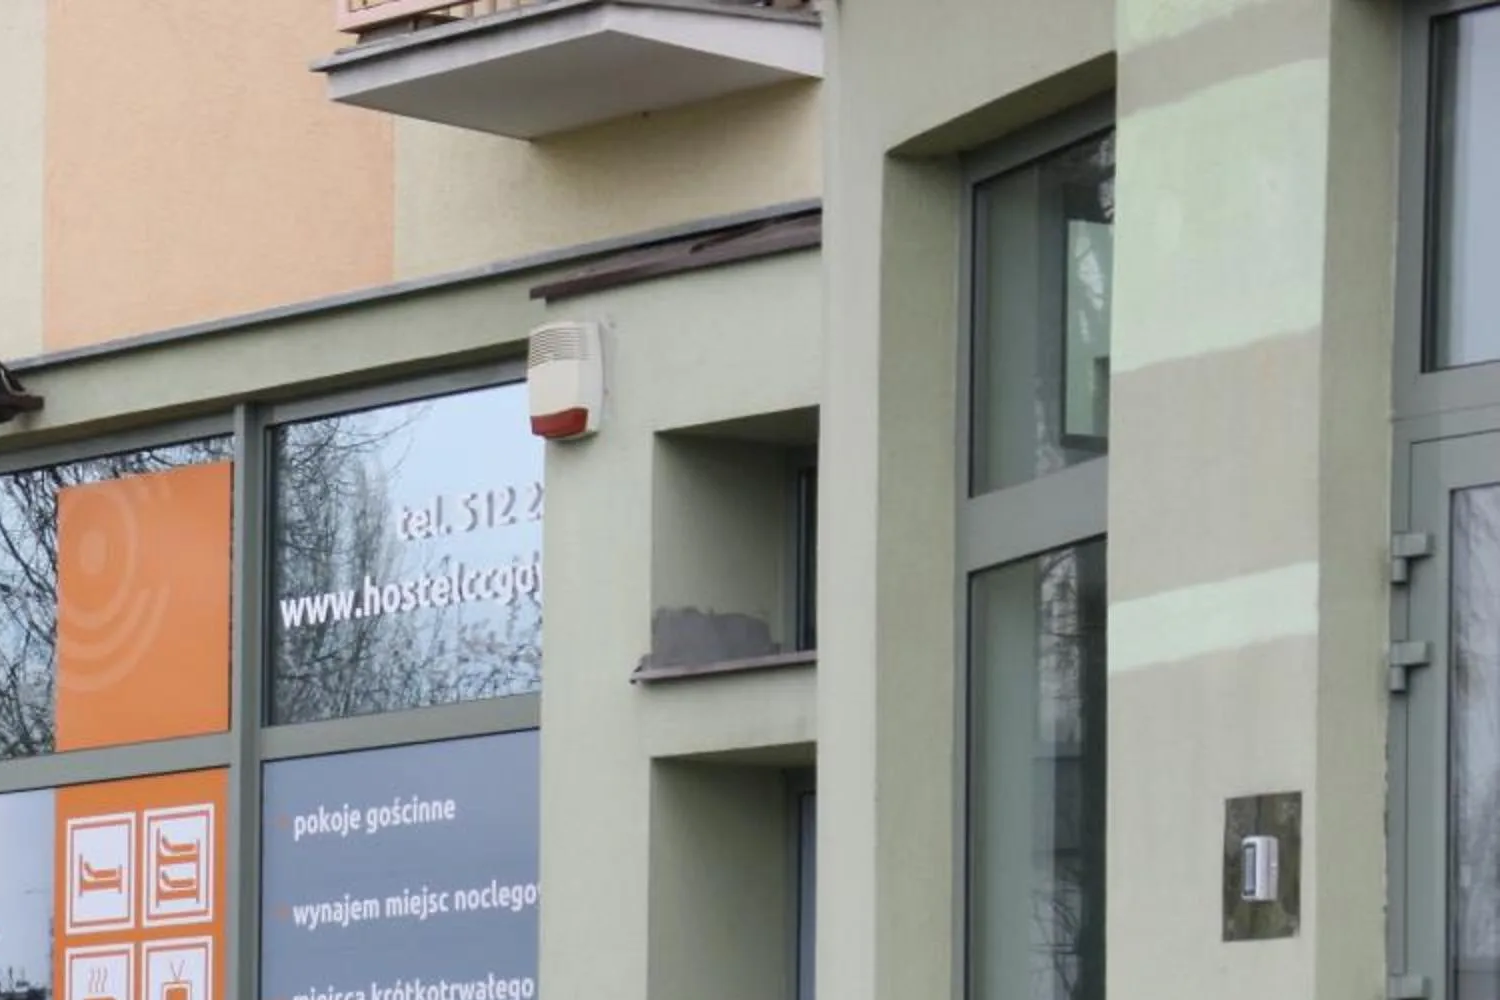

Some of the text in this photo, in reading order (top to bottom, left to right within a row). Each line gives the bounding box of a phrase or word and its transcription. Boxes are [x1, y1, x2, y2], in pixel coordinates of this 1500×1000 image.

[397, 494, 452, 541] tel.
[459, 486, 518, 533] 512
[293, 794, 457, 842] pokoje gościnne
[293, 893, 380, 931] wynajem
[385, 885, 450, 920] miejsc
